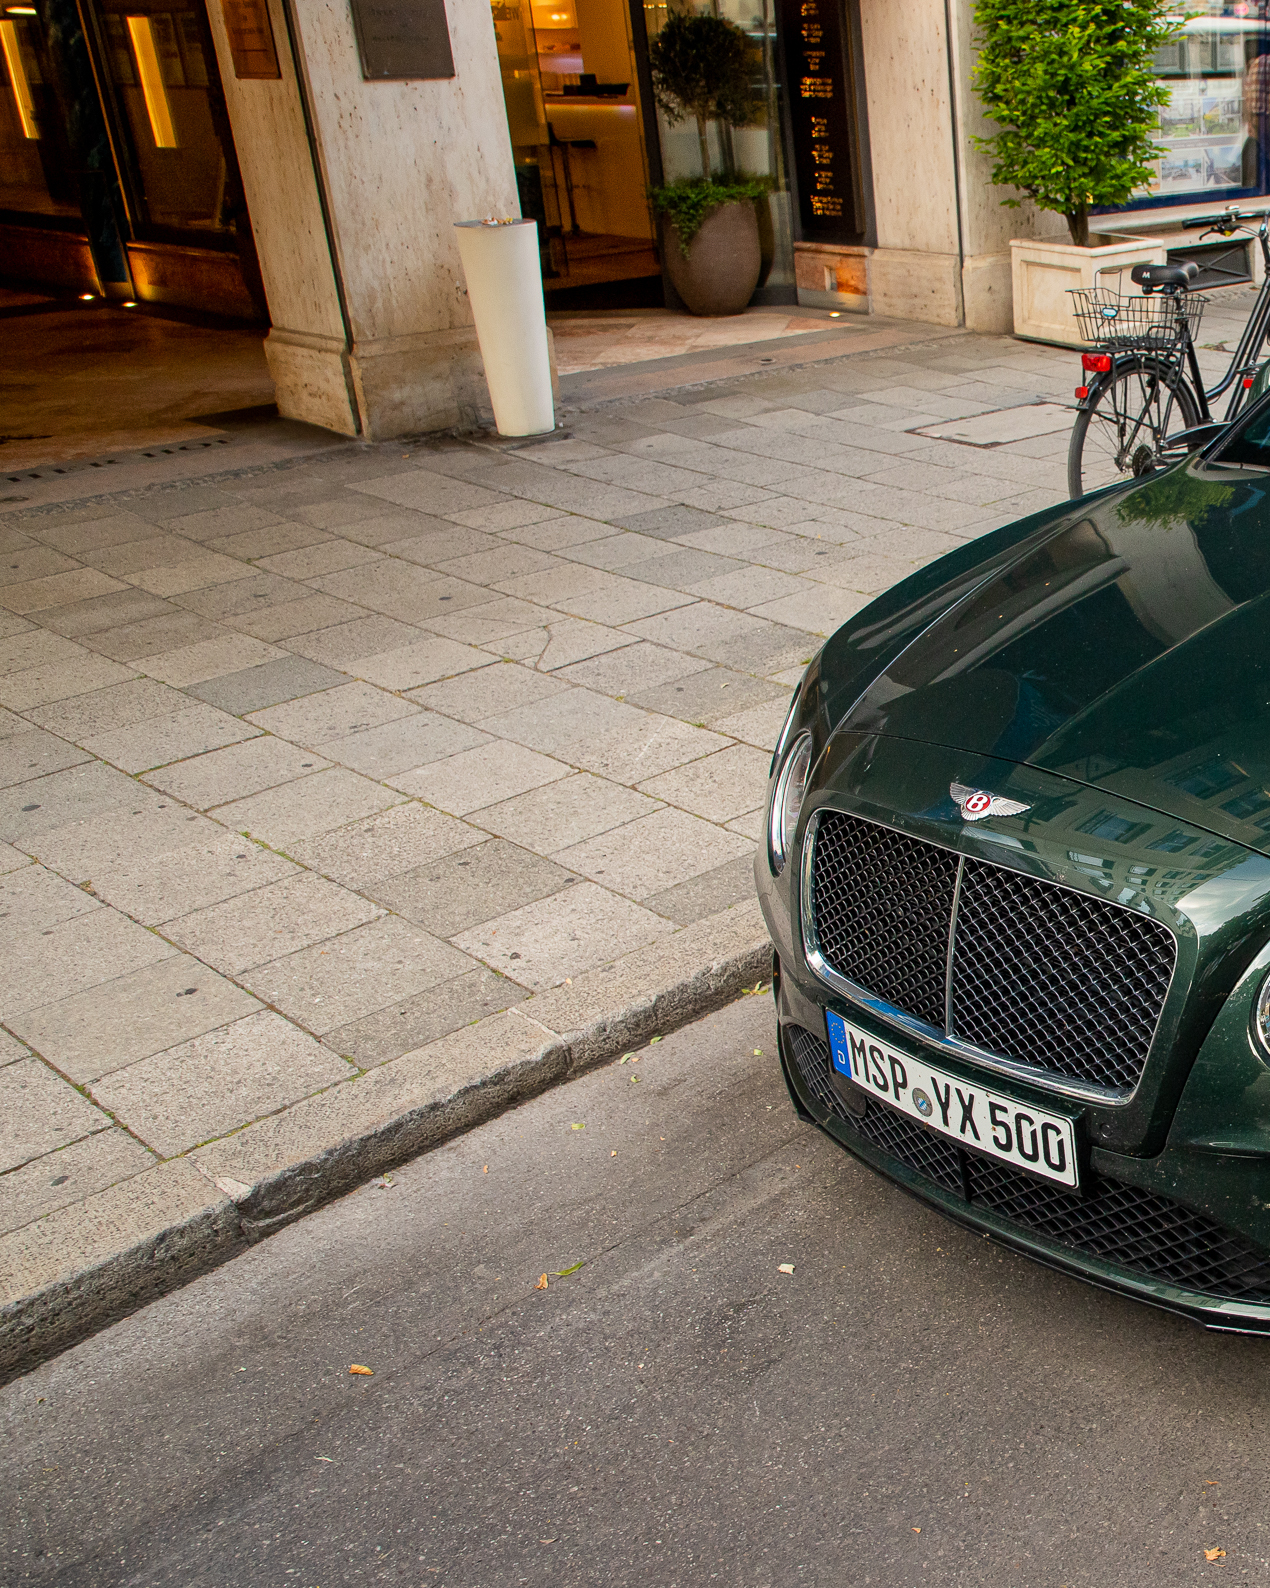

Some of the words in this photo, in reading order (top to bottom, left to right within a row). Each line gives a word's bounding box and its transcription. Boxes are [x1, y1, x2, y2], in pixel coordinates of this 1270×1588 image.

[837, 1049, 846, 1065] D
[848, 1031, 908, 1102] MSP
[930, 1076, 981, 1142] YX
[988, 1100, 1067, 1174] 500
